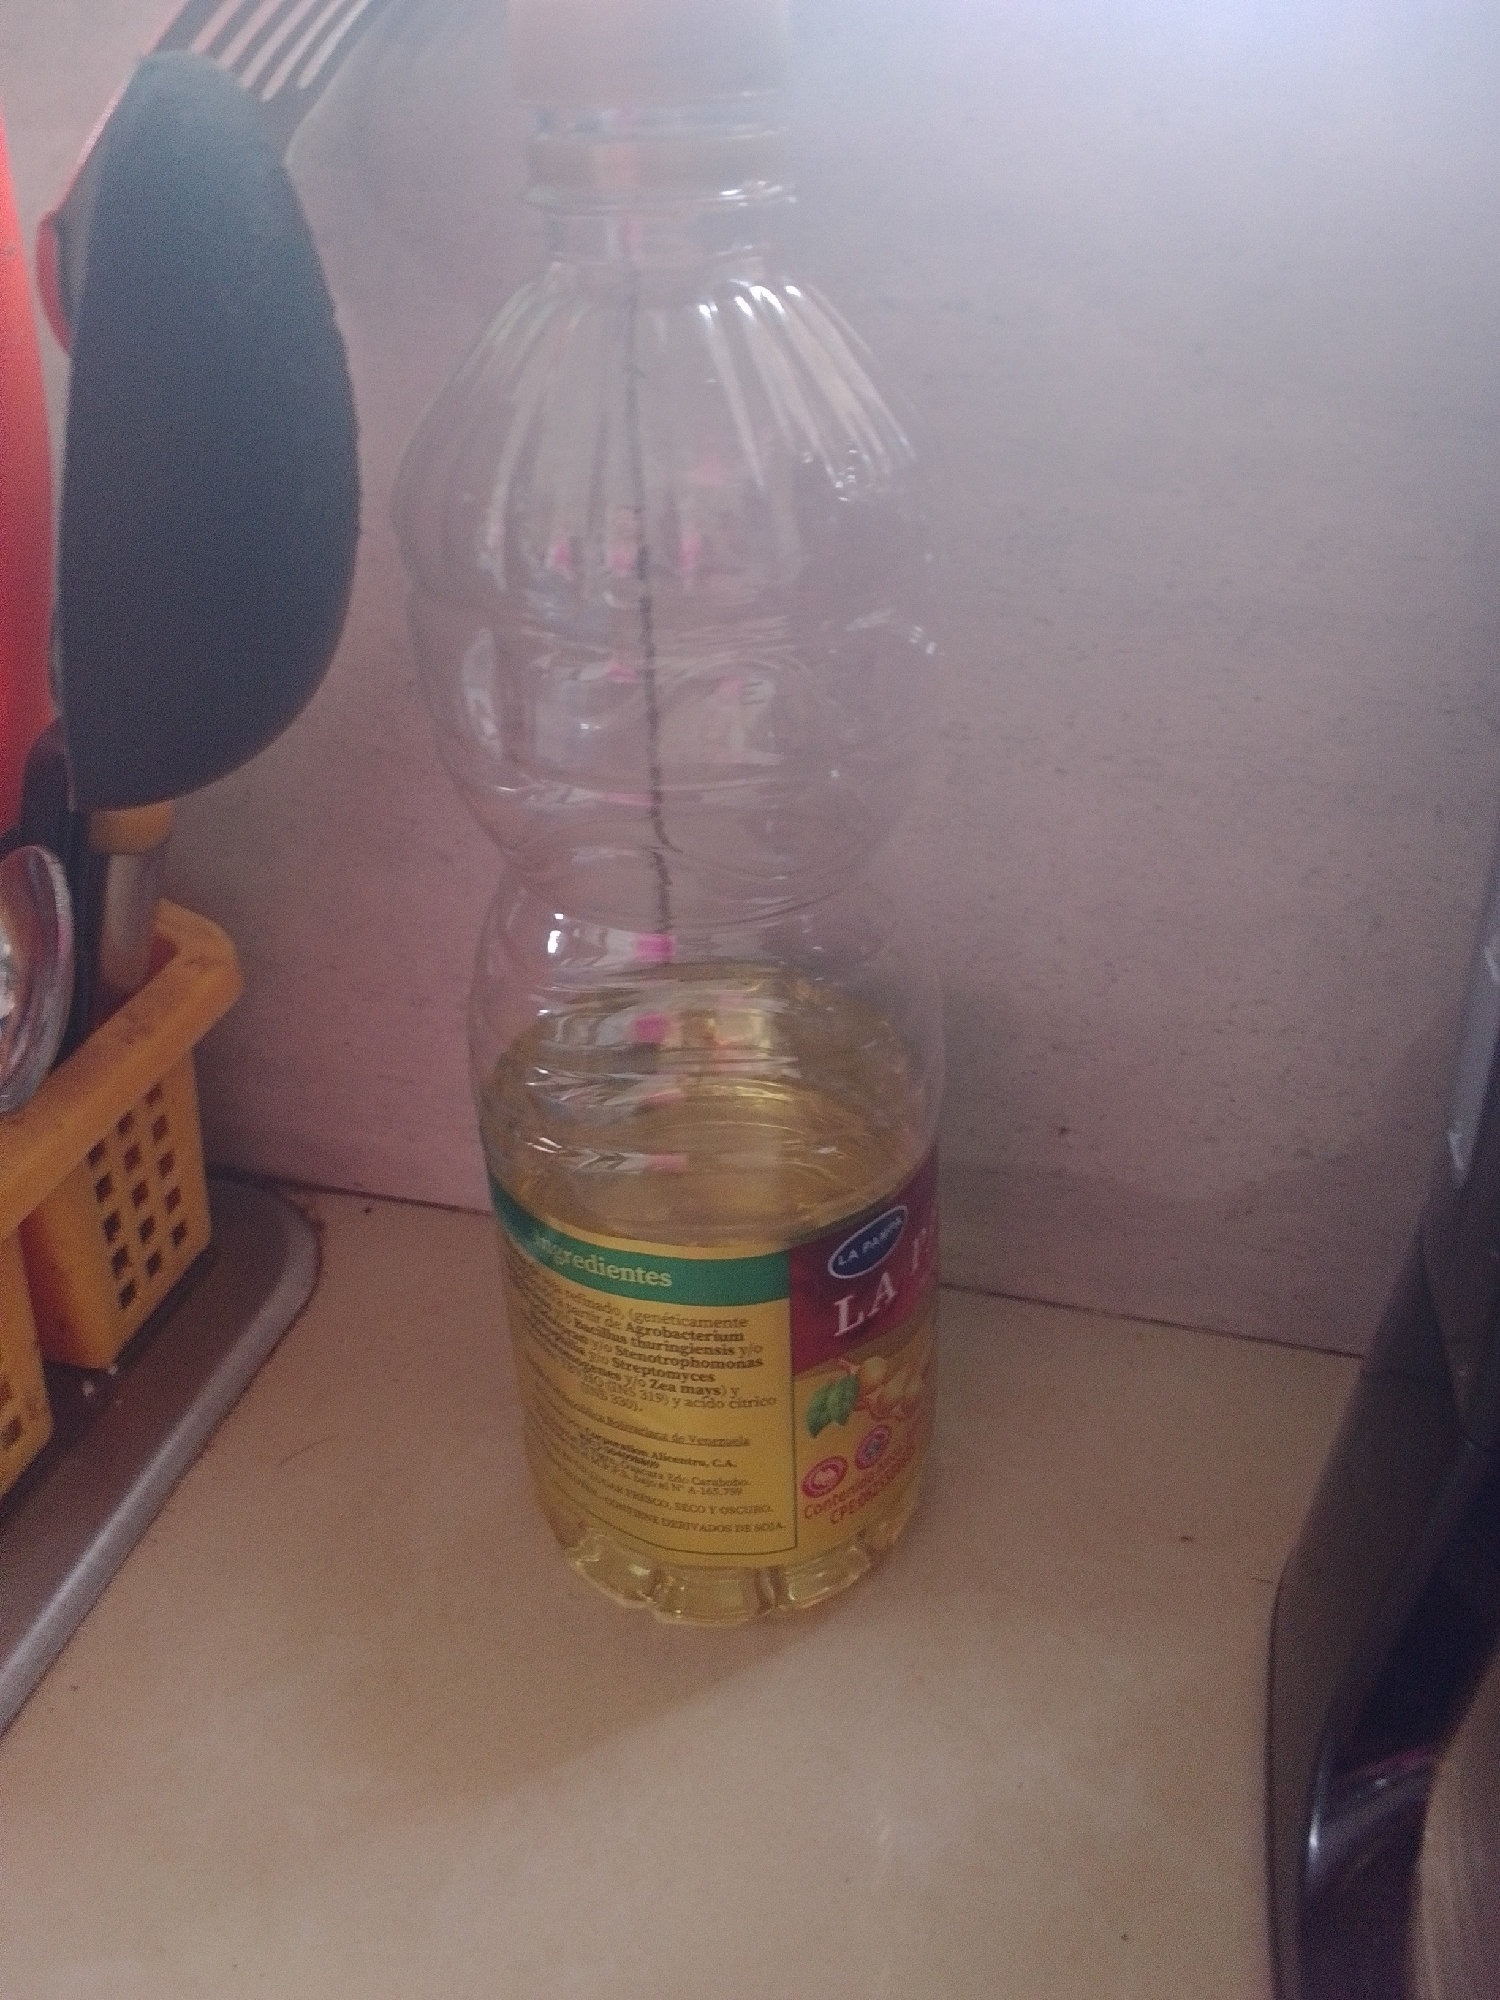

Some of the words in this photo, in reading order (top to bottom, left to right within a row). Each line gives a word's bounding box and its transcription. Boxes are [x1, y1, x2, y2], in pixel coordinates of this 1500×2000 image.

[833, 1271, 899, 1337] LA
[625, 1322, 745, 1342] Agrobacterium
[615, 1344, 764, 1370] Stenotrophomonas
[630, 1337, 735, 1356] thuringiensis
[611, 1356, 717, 1384] Streptomyces
